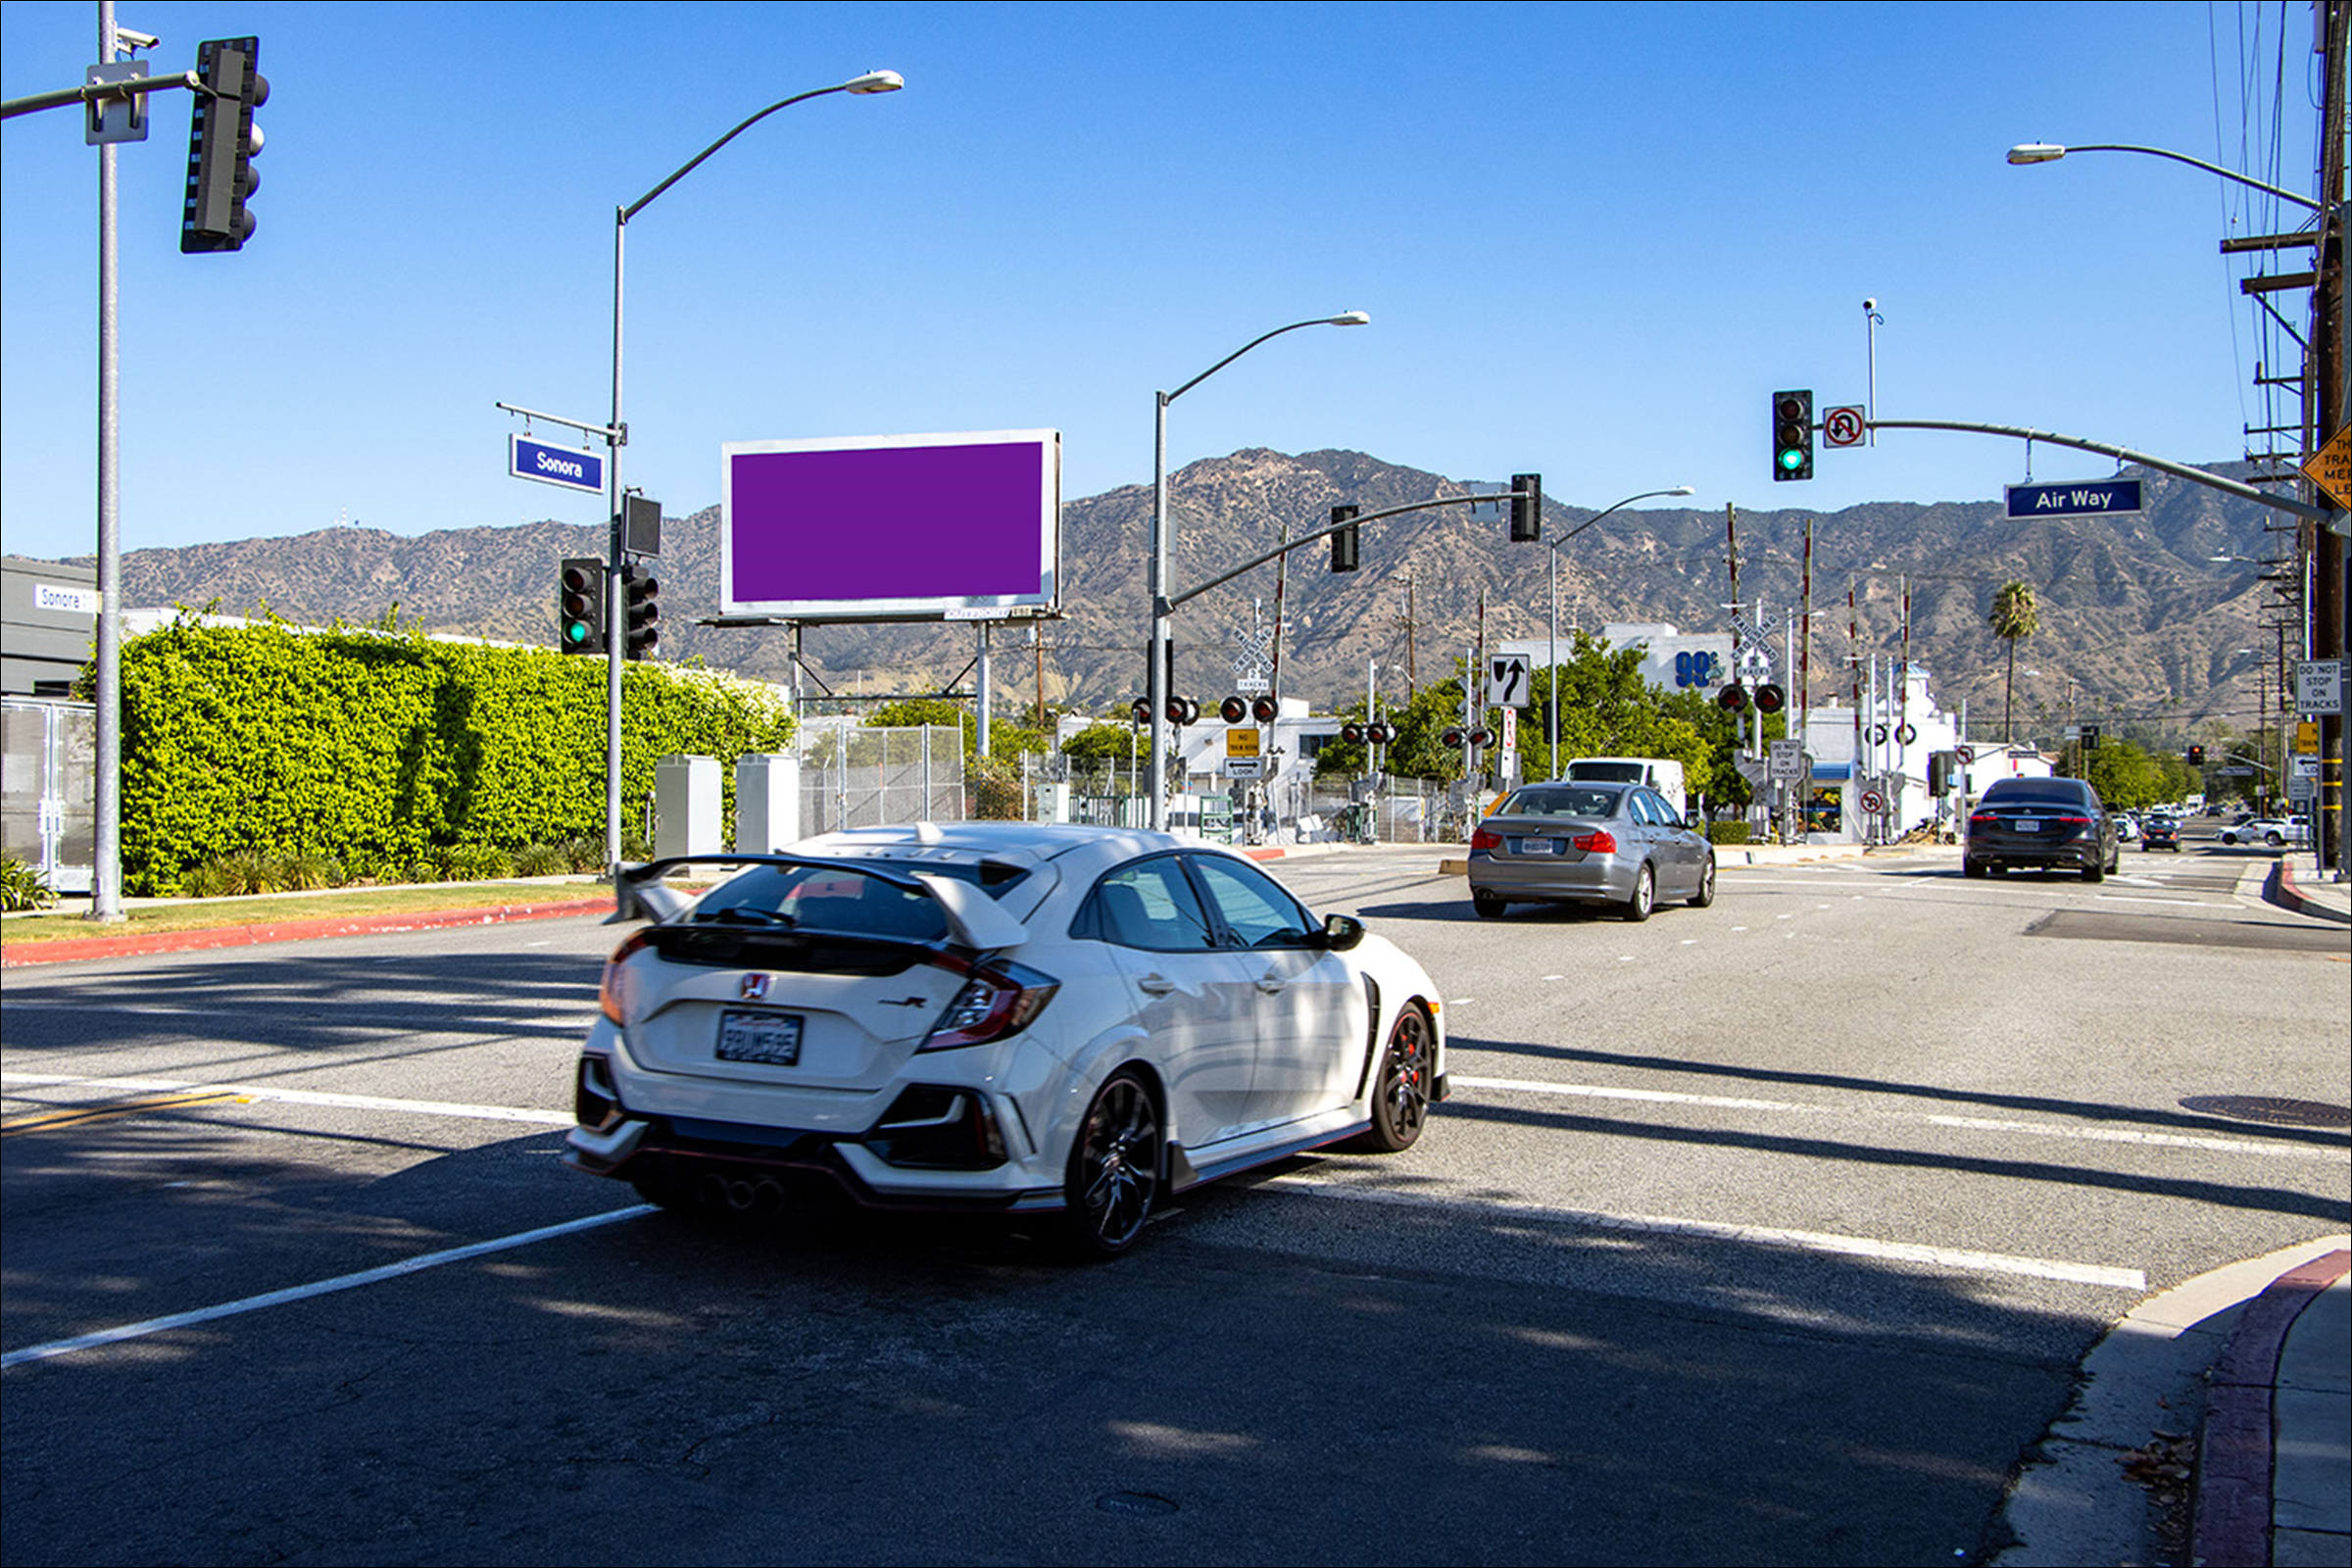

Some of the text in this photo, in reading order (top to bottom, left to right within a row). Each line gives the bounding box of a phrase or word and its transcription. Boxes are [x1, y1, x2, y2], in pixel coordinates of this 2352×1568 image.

[2336, 440, 2351, 450] TH
[536, 451, 583, 478] Sonora
[2325, 455, 2351, 465] TRA
[2335, 484, 2351, 495] LE
[2035, 490, 2112, 509] Air Way
[42, 588, 79, 608] Sonora
[2299, 664, 2337, 674] DO NOT
[2306, 676, 2331, 686] STOP
[2312, 688, 2327, 697] ON
[2300, 699, 2339, 709] TRACKS
